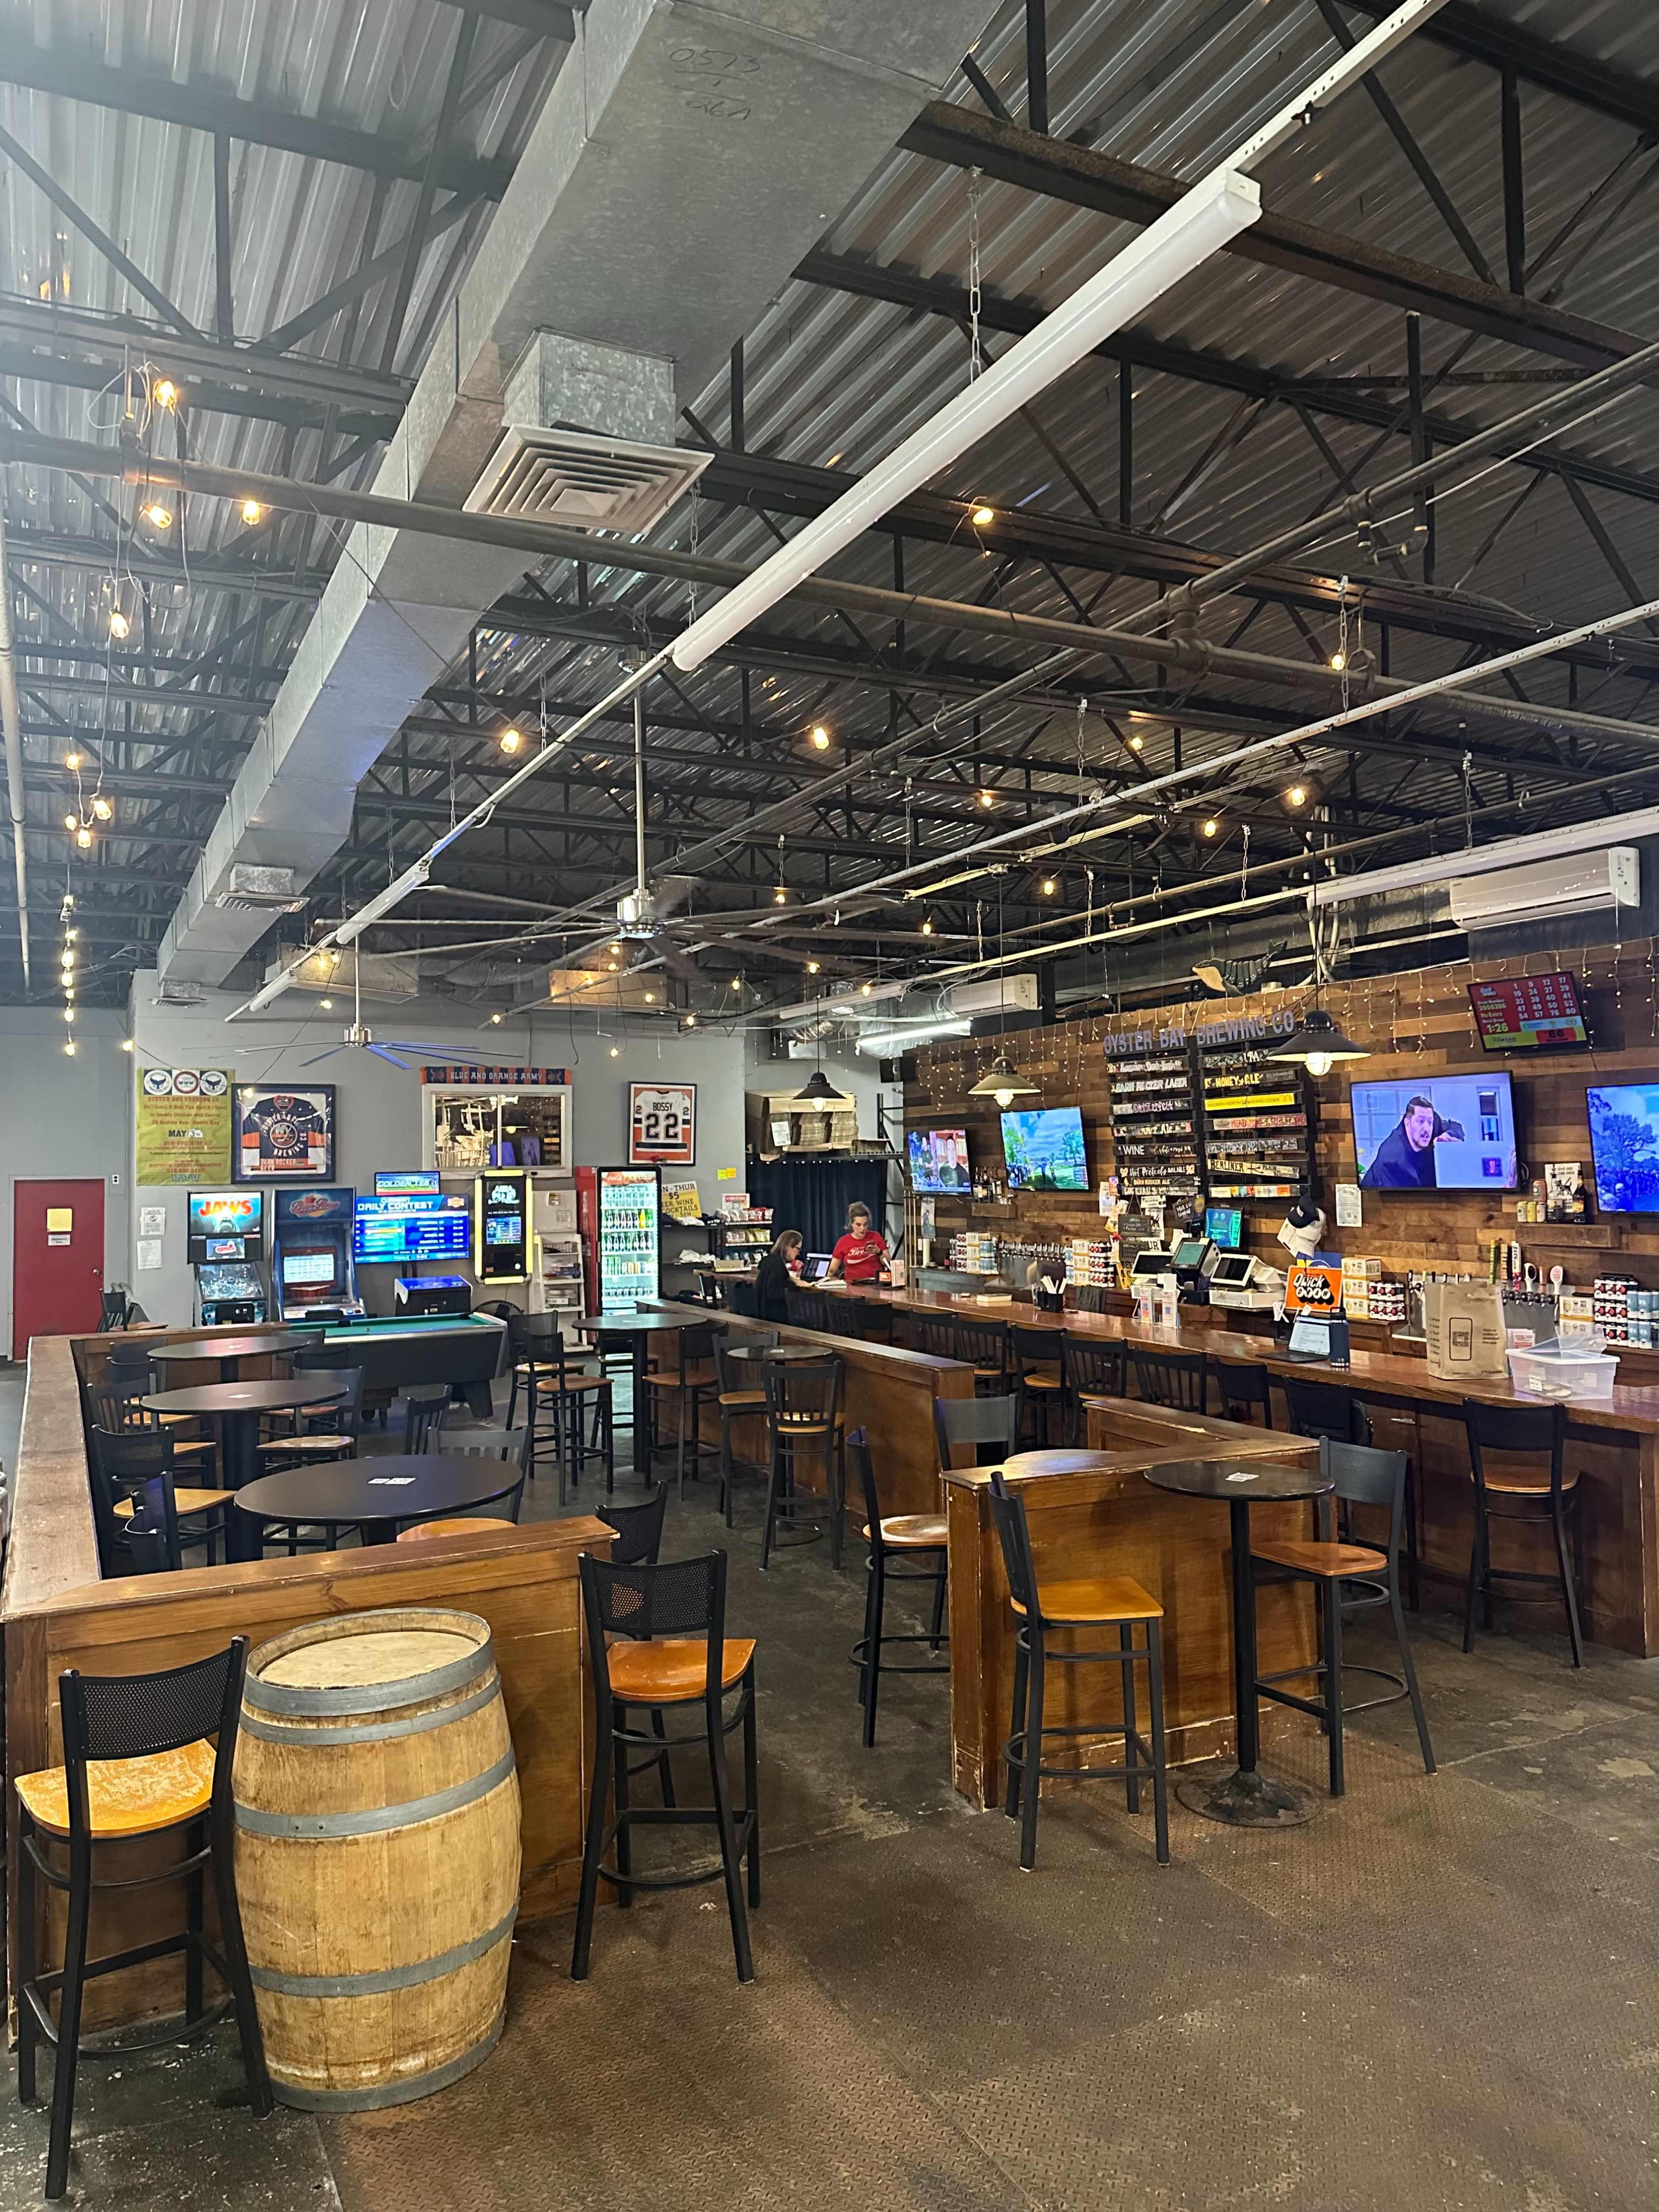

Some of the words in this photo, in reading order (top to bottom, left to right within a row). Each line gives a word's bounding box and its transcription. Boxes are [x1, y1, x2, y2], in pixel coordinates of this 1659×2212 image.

[1104, 1030, 1153, 1054] OYSTER
[1160, 1027, 1185, 1048] BAY
[1196, 1016, 1265, 1045] BREWING
[1272, 1011, 1295, 1034] CO
[1487, 1023, 1509, 1033] 1:26
[1243, 1051, 1260, 1063] IPA
[1244, 1073, 1260, 1084] ALE
[653, 1102, 673, 1111] BOSSY
[645, 1112, 679, 1140] 22
[1261, 1117, 1295, 1126] SANGRIA
[273, 1143, 304, 1157] BREWING
[1123, 1145, 1145, 1155] WINE
[1129, 1168, 1140, 1177] Hot
[1142, 1166, 1166, 1177] Pretzels
[1211, 1160, 1244, 1172] BERLINER
[200, 1199, 252, 1217] JAWS
[357, 1202, 385, 1211] DAILY
[387, 1201, 433, 1210] CONTEST
[1148, 1241, 1159, 1250] UR
[1293, 1273, 1325, 1287] Quick
[1296, 1287, 1331, 1300] DRAW
